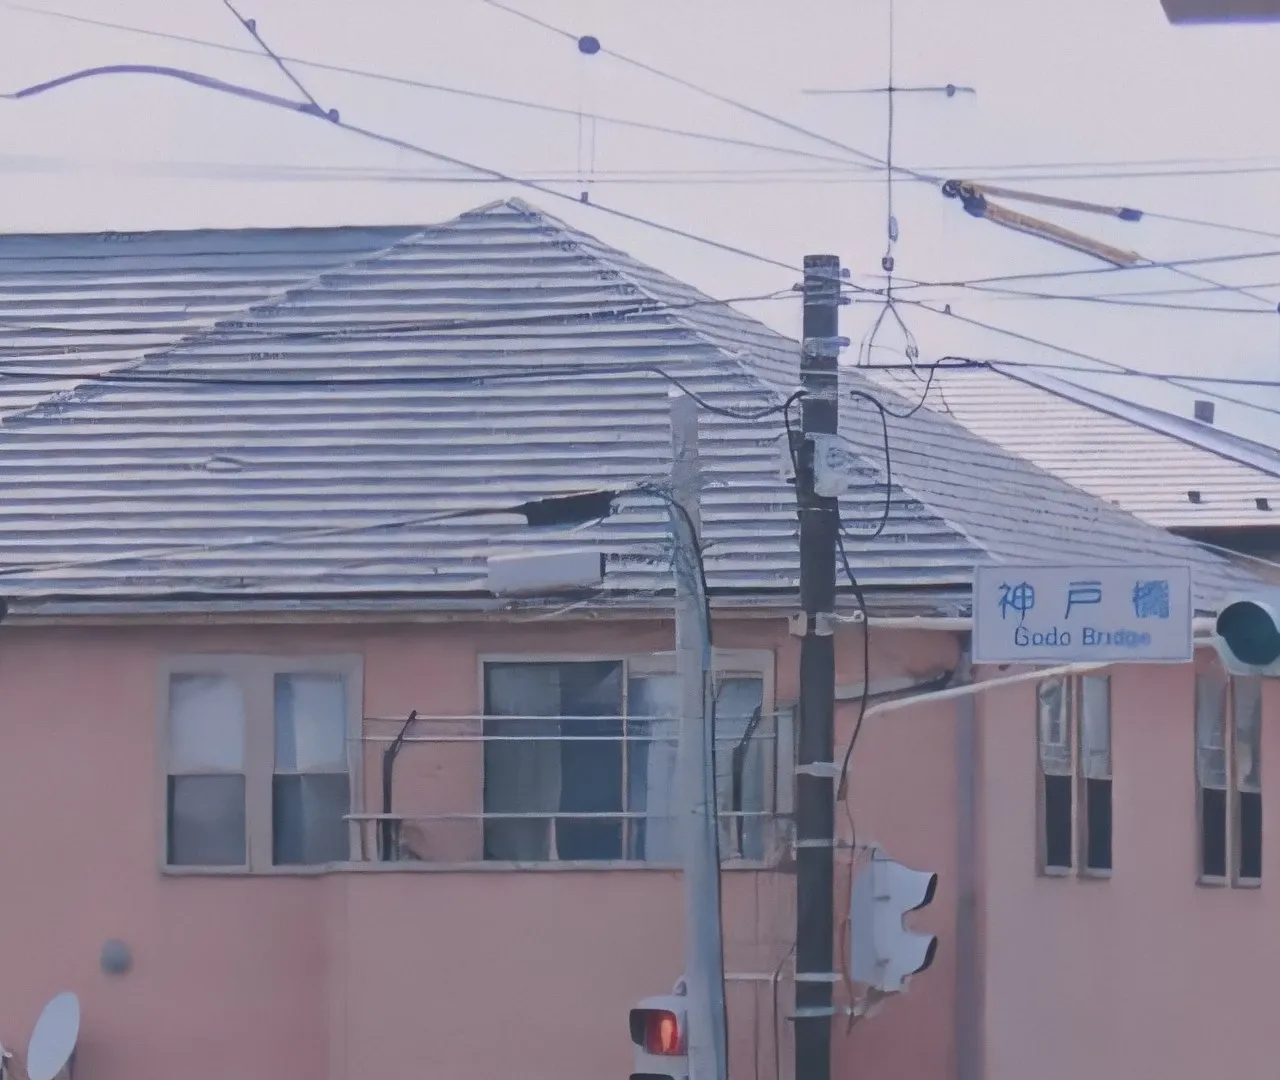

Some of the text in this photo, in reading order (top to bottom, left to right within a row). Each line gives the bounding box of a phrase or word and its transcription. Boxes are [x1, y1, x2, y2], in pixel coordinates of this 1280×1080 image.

[998, 580, 1170, 620] 神戸橋
[1014, 626, 1072, 646] Godo
